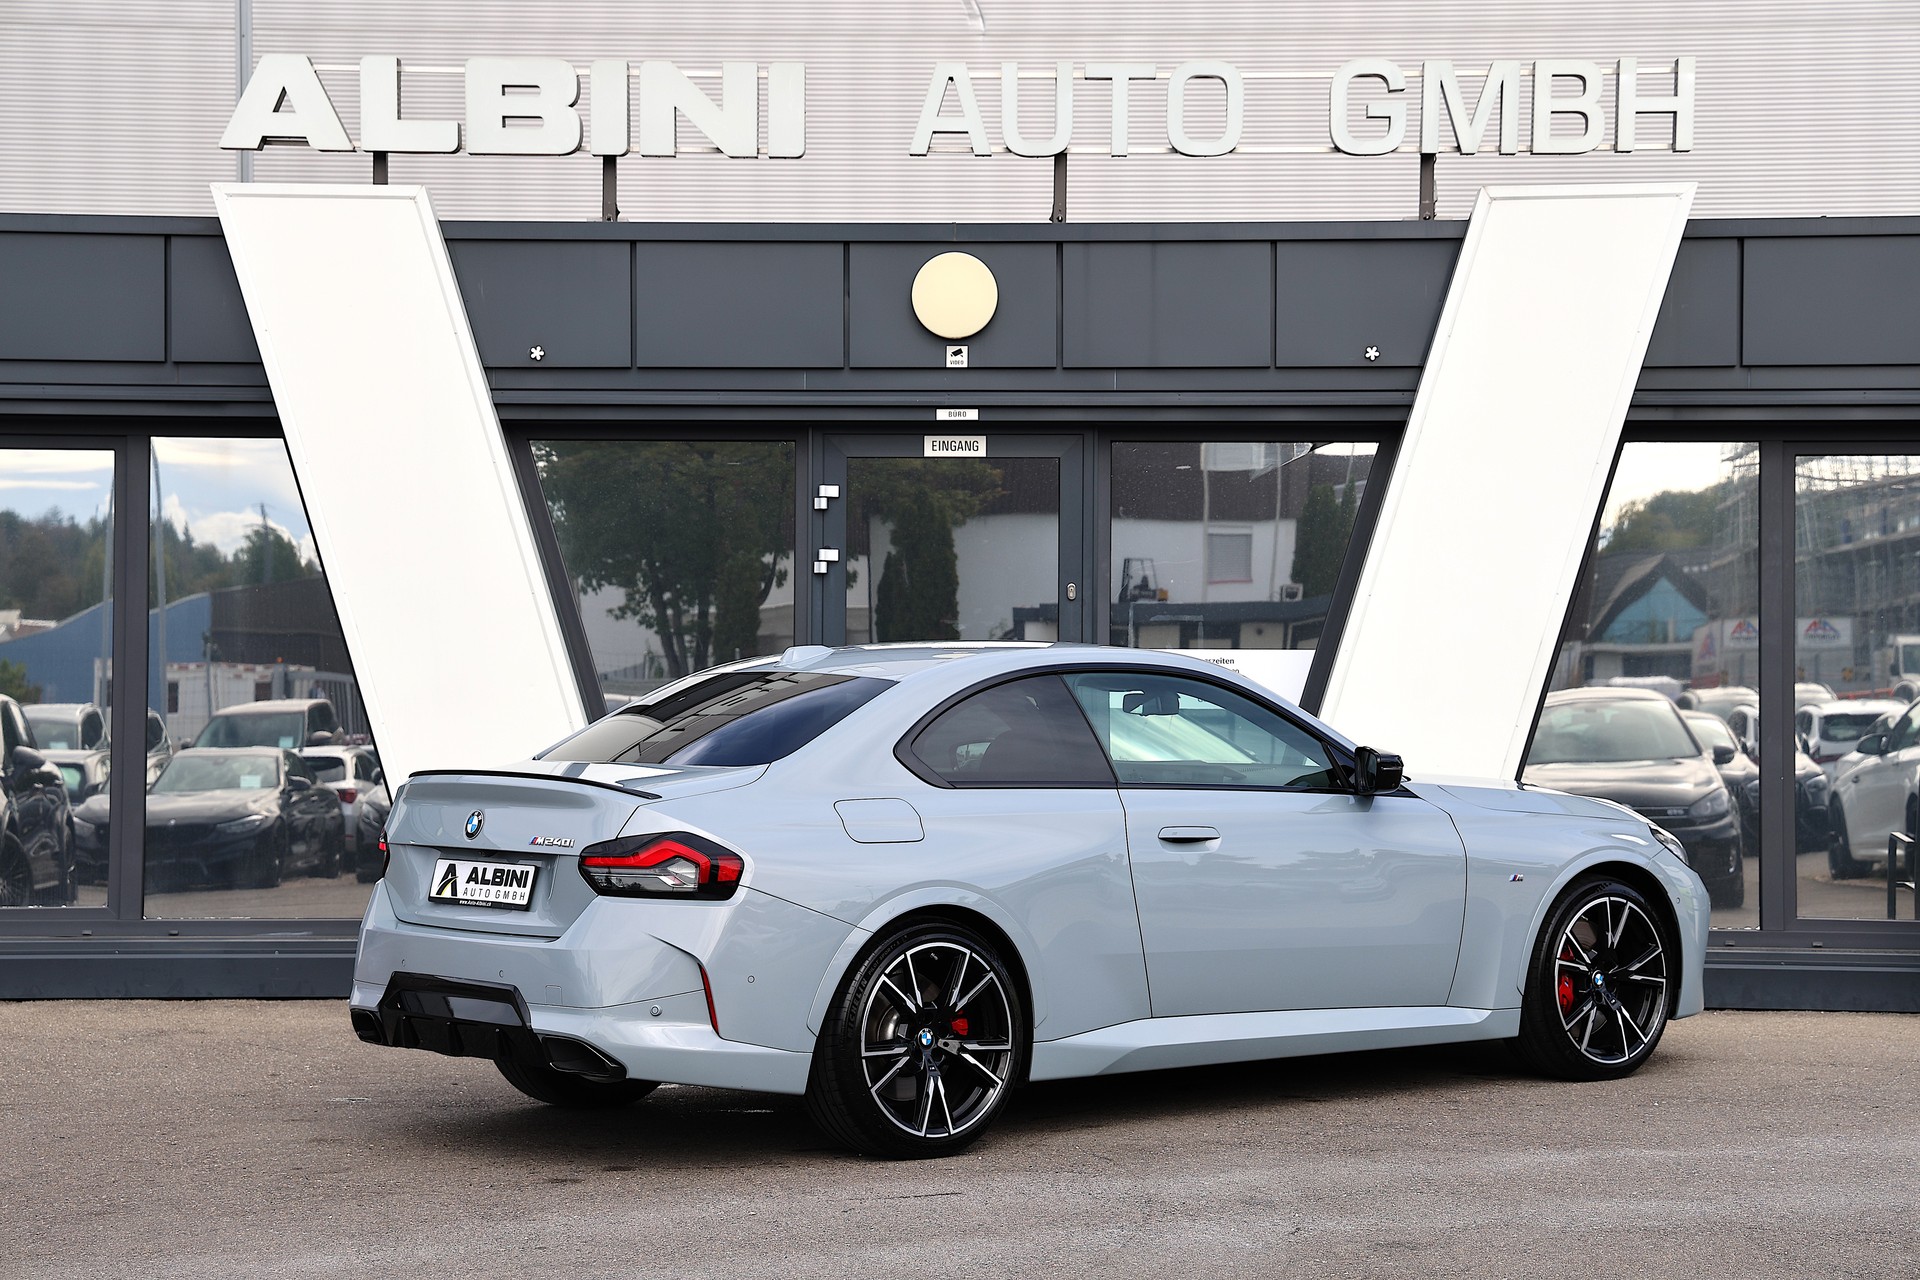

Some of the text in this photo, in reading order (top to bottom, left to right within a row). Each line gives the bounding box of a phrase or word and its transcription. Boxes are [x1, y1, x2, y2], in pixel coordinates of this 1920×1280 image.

[218, 53, 1697, 159] ALBINI AUTO GMBH
[948, 410, 967, 418] BÜRO
[931, 440, 979, 452] EINGANG
[466, 866, 530, 889] ALBINI
[463, 887, 526, 901] AUTO GMBH
[846, 978, 868, 1039] MICHELIN
